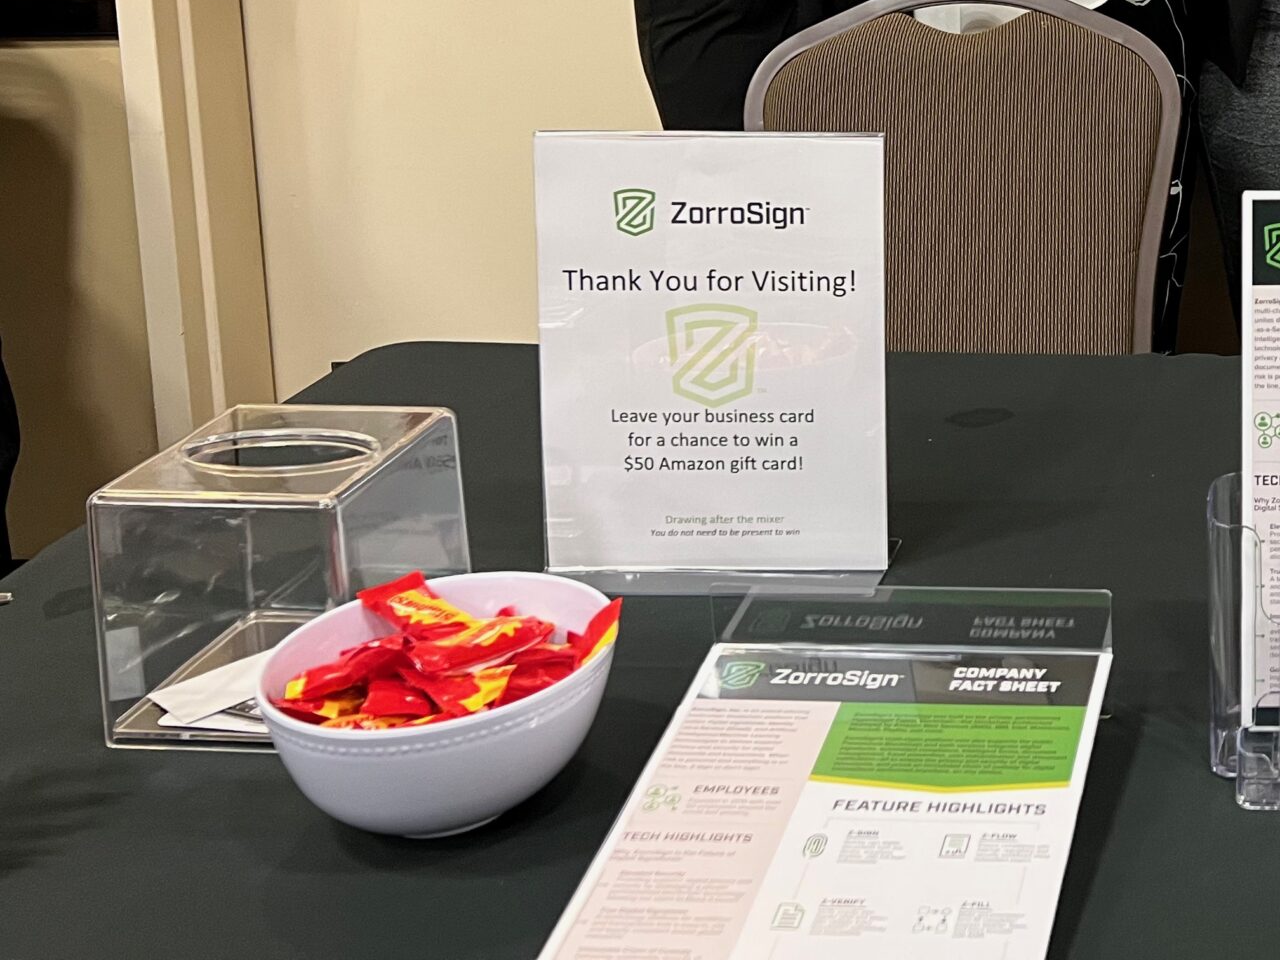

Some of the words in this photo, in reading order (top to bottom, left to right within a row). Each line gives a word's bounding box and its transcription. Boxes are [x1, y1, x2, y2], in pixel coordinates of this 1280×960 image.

[671, 201, 806, 229] ZorroSign
[563, 269, 641, 291] Thank
[649, 270, 698, 292] You
[707, 269, 743, 292] for
[752, 270, 856, 297] Visiting!
[611, 409, 657, 423] Leave
[663, 412, 699, 427] your
[705, 409, 774, 423] business
[779, 409, 814, 423] card
[628, 432, 651, 447] for
[656, 436, 665, 447] a
[671, 433, 728, 447] chance
[733, 434, 750, 447] to
[755, 433, 784, 447] win
[789, 436, 798, 447] a
[623, 456, 654, 473] $50
[659, 457, 725, 471] Amazon
[730, 456, 757, 475] gift
[762, 457, 803, 471] card!
[1254, 498, 1269, 506] Why
[665, 515, 706, 526] Drawing
[709, 515, 734, 524] after
[737, 515, 753, 524] the
[756, 515, 784, 524] mixer
[741, 529, 773, 538] present
[770, 668, 899, 689] ZorroSign
[954, 667, 1048, 679] COMPANY
[950, 680, 998, 691] FACT
[999, 680, 1061, 693] SHEET
[693, 785, 780, 795] EMPLOYEES
[832, 799, 922, 812] FEATURE
[927, 801, 1047, 816] HIGHLIGHTS
[622, 831, 662, 840] TECH
[664, 832, 753, 842] HIGHLIGHTS
